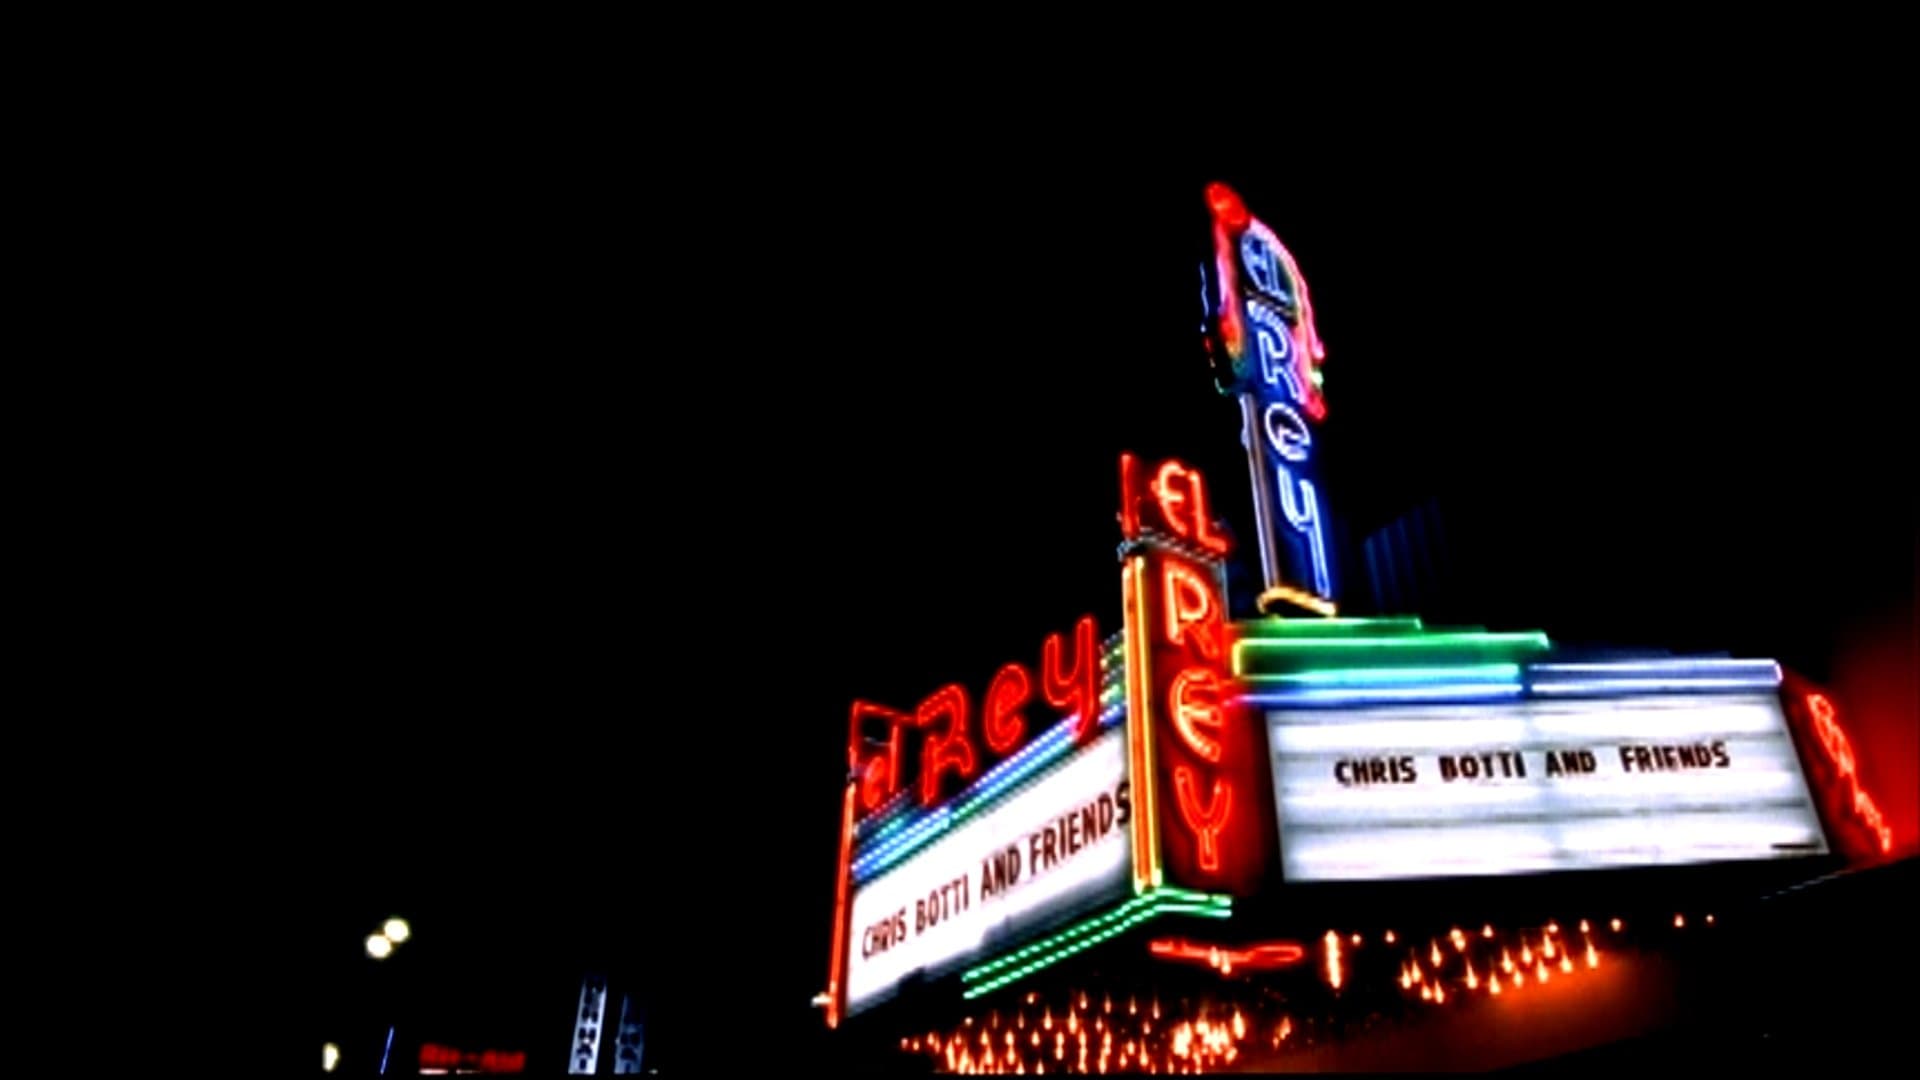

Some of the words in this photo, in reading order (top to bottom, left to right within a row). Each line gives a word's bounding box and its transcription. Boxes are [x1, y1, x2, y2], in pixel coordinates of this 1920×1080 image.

[1150, 458, 1228, 552] EL
[916, 613, 1098, 808] Rey
[1162, 559, 1234, 873] REY
[1334, 757, 1417, 786] CHRIS
[1439, 752, 1527, 782] BOTTI
[1545, 747, 1597, 778] AND
[1619, 741, 1731, 774] FRIENDS
[861, 904, 907, 960] CHRIS
[915, 873, 970, 935] BOTTI
[980, 845, 1022, 901] AND
[1029, 780, 1131, 876] FRIENDS
